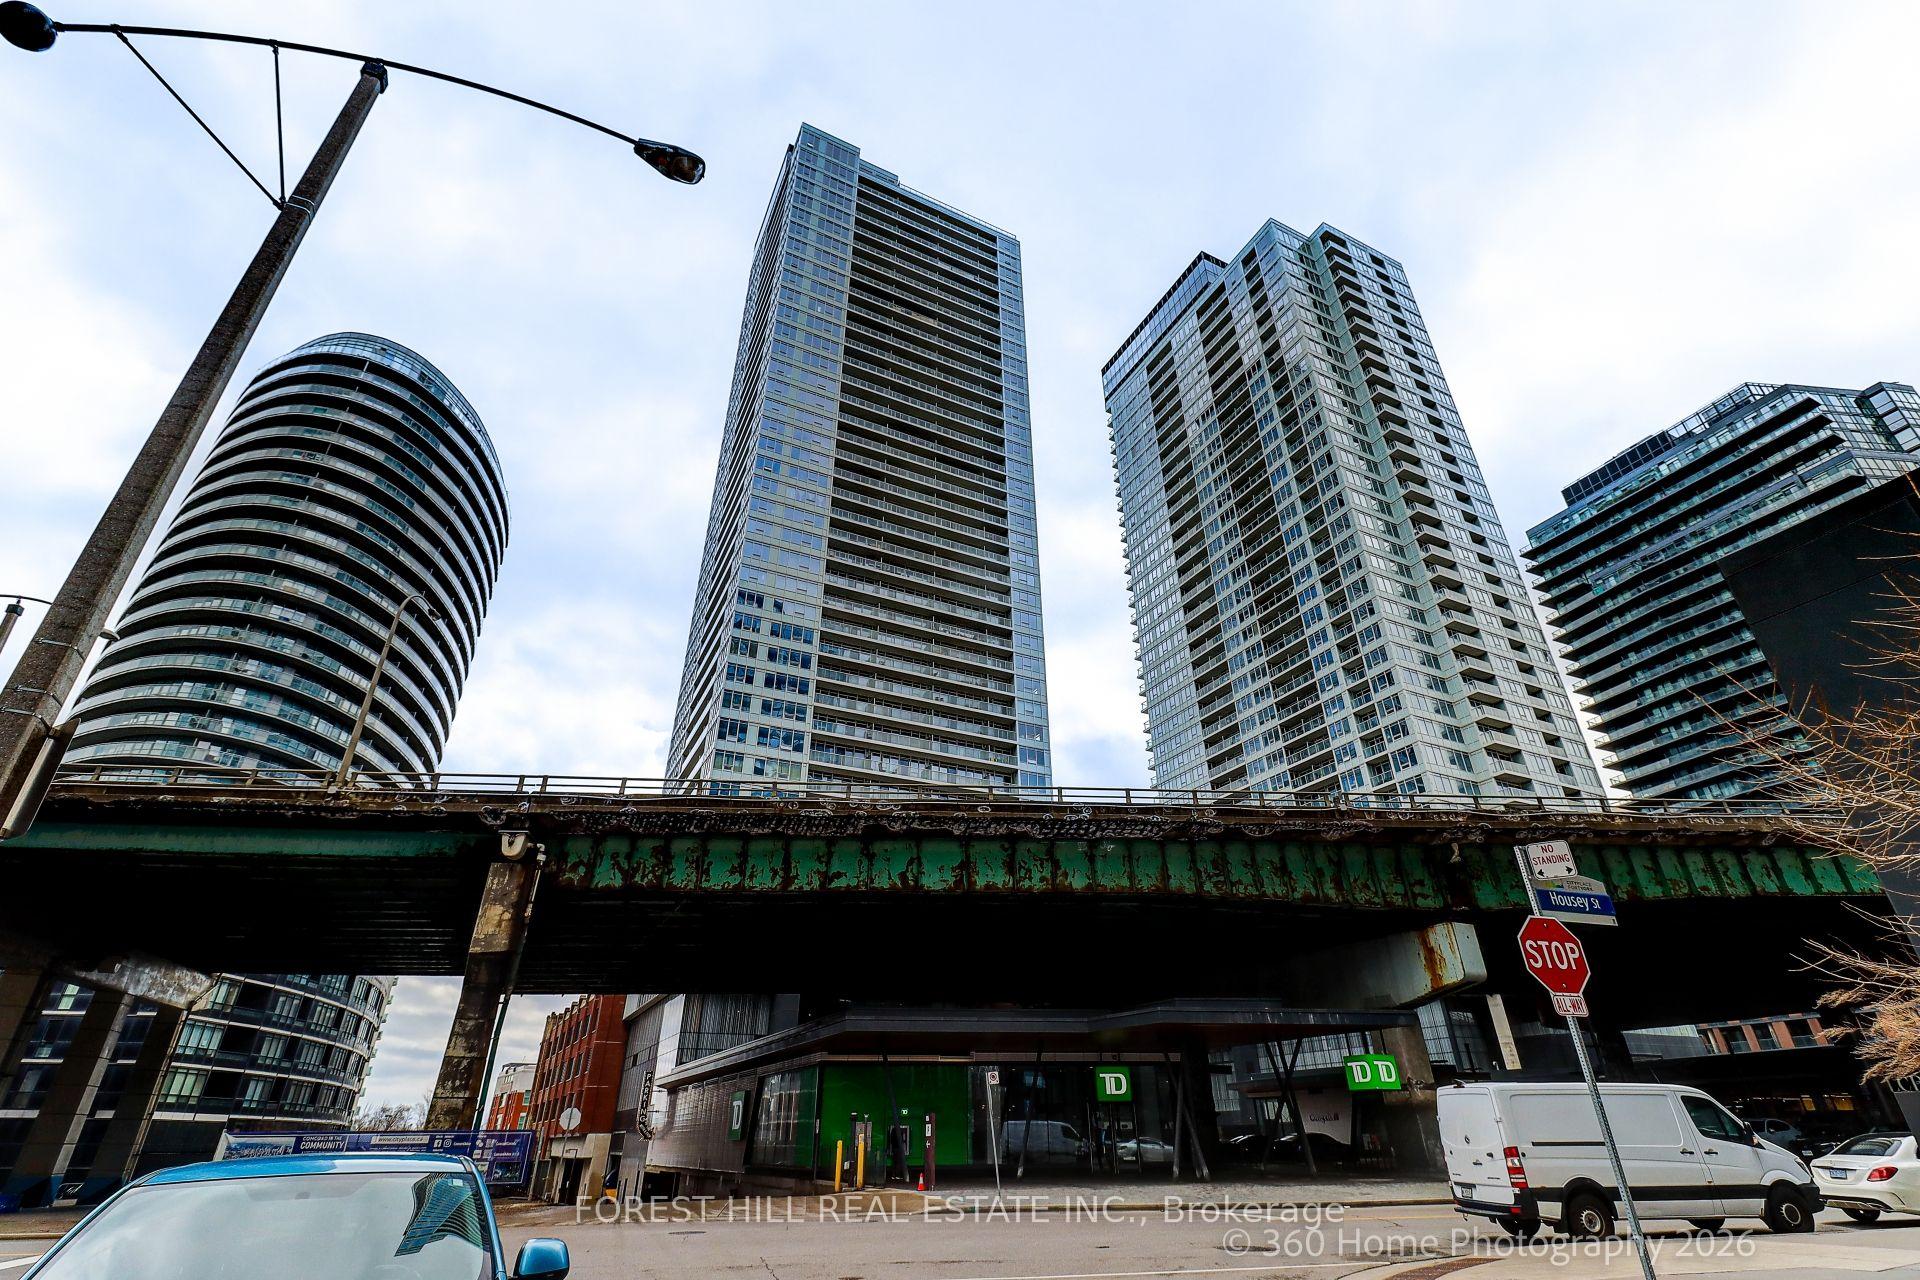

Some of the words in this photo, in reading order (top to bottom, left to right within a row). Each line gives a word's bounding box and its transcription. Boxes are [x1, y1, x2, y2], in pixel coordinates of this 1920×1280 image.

[1541, 844, 1554, 854] NO
[1532, 853, 1570, 866] STANDING
[1549, 891, 1590, 911] Housey
[1591, 898, 1602, 909] St
[1525, 940, 1580, 970] STOP
[1555, 998, 1586, 1013] ALL-WAY
[1347, 1061, 1372, 1083] TD
[1374, 1060, 1397, 1083] TD
[1099, 1073, 1127, 1095] TD
[640, 1073, 651, 1123] PARKING
[300, 1141, 345, 1150] COMMUNITY
